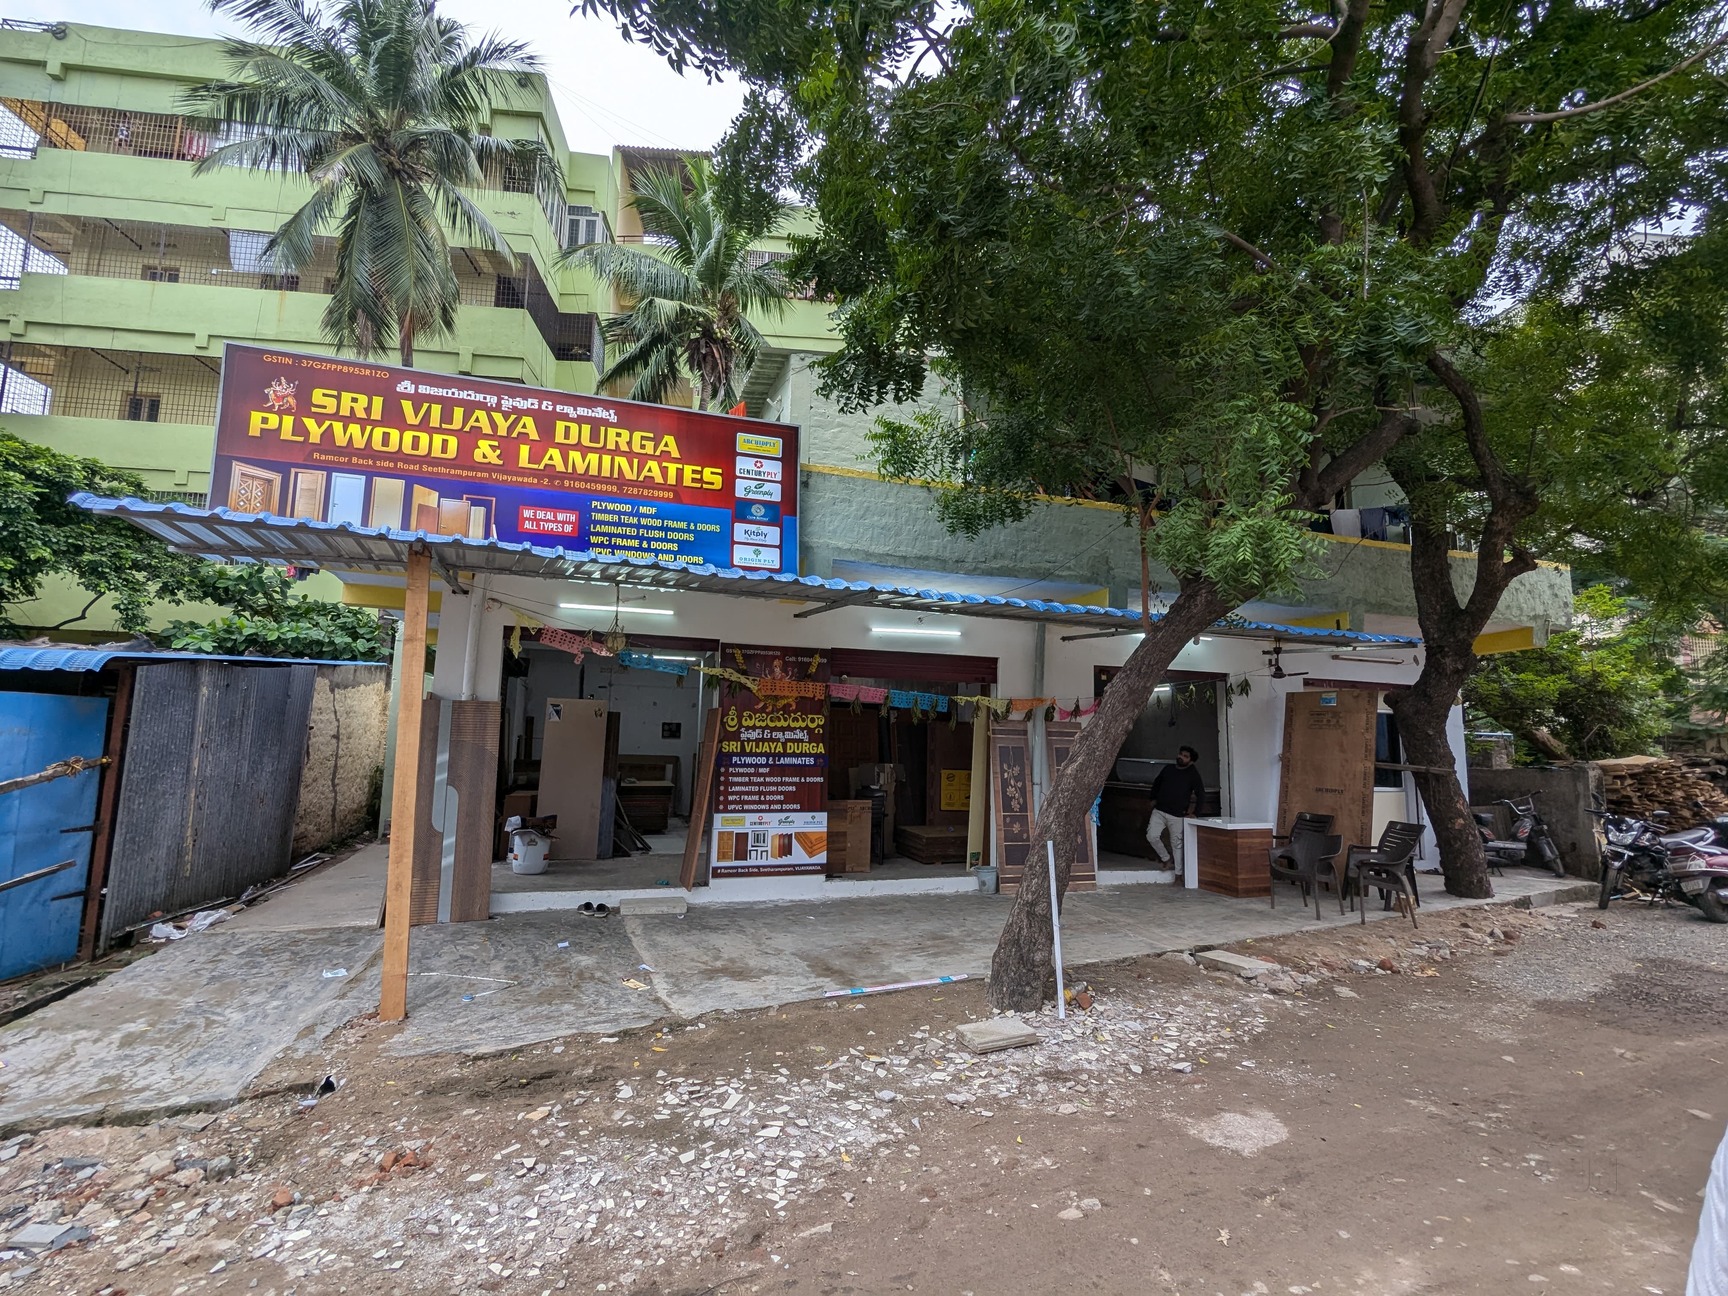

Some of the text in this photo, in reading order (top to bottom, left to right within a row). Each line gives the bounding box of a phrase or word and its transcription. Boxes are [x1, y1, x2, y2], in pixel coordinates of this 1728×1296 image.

[263, 355, 292, 364] GSTIN
[542, 401, 553, 411] &
[311, 388, 682, 459] SRI VIJAYA DURGA
[248, 410, 723, 491] PLYWOOD & LAMINATES
[313, 452, 348, 463] Ramcor
[352, 456, 373, 465] Back
[376, 459, 394, 468] side
[397, 461, 419, 470] Road
[422, 464, 489, 479] Seethrampuram
[492, 472, 538, 484] Vijayawada
[622, 486, 674, 499] 7287829999
[739, 468, 777, 478] CENTURYPLY
[744, 485, 773, 498] Greenply
[592, 501, 631, 513] PLYWOOD
[639, 506, 657, 515] MDF
[523, 509, 576, 522] WE DEAL WITH
[524, 521, 573, 533] ALL TYPES OF
[591, 513, 619, 522] TIMBER
[621, 515, 639, 524] TEAK
[640, 517, 662, 527] WOOD
[664, 519, 688, 529] FRAME
[697, 522, 720, 532] DOORS
[591, 524, 694, 541] LAMINATED FLUSH DOORS
[744, 529, 768, 539] Kitply
[590, 536, 678, 551] WPC FRAME & DOORS
[658, 552, 674, 561] AND
[677, 555, 703, 564] DOORS
[724, 706, 824, 733] శ్రీ విజయదుర్గా
[764, 729, 771, 738] &
[722, 741, 825, 753] SRI VIJAYA DURGA
